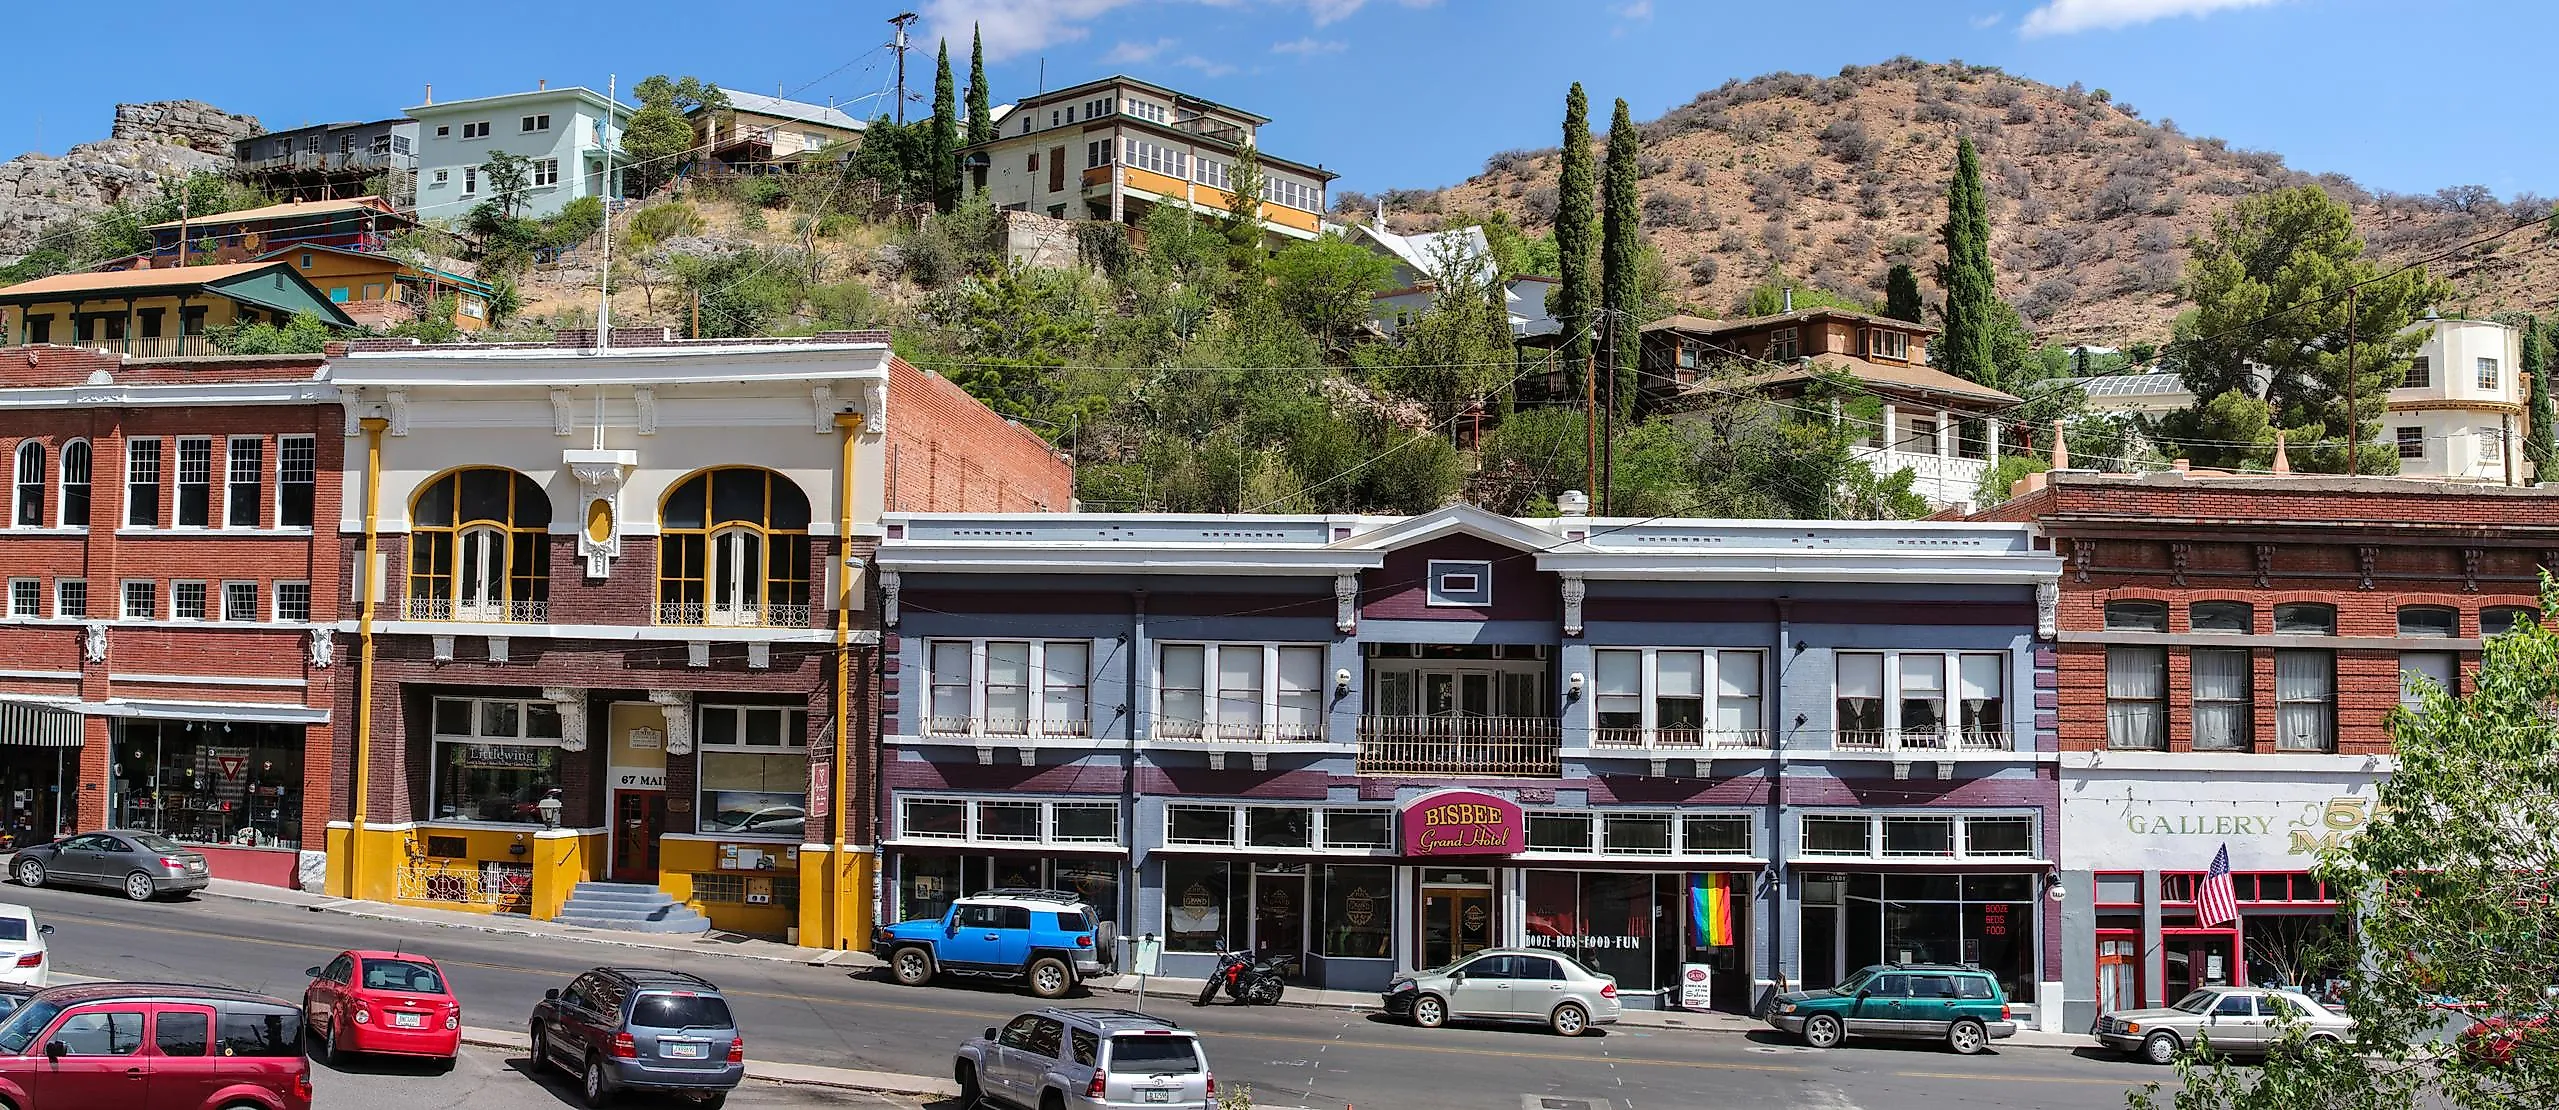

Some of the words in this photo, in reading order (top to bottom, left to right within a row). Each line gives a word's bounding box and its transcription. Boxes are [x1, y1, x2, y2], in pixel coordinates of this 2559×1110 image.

[471, 745, 534, 762] Littlewing
[621, 776, 636, 784] 67
[1425, 804, 1502, 826] BISBEE
[2128, 815, 2278, 835] GALLERY
[1420, 828, 1463, 853] Grand
[1464, 826, 1511, 847] Hotel
[1985, 904, 2009, 913] BOOZE
[1985, 915, 2005, 924] BEDS
[1986, 926, 2006, 935] FOOD
[1615, 936, 1640, 949] FUN
